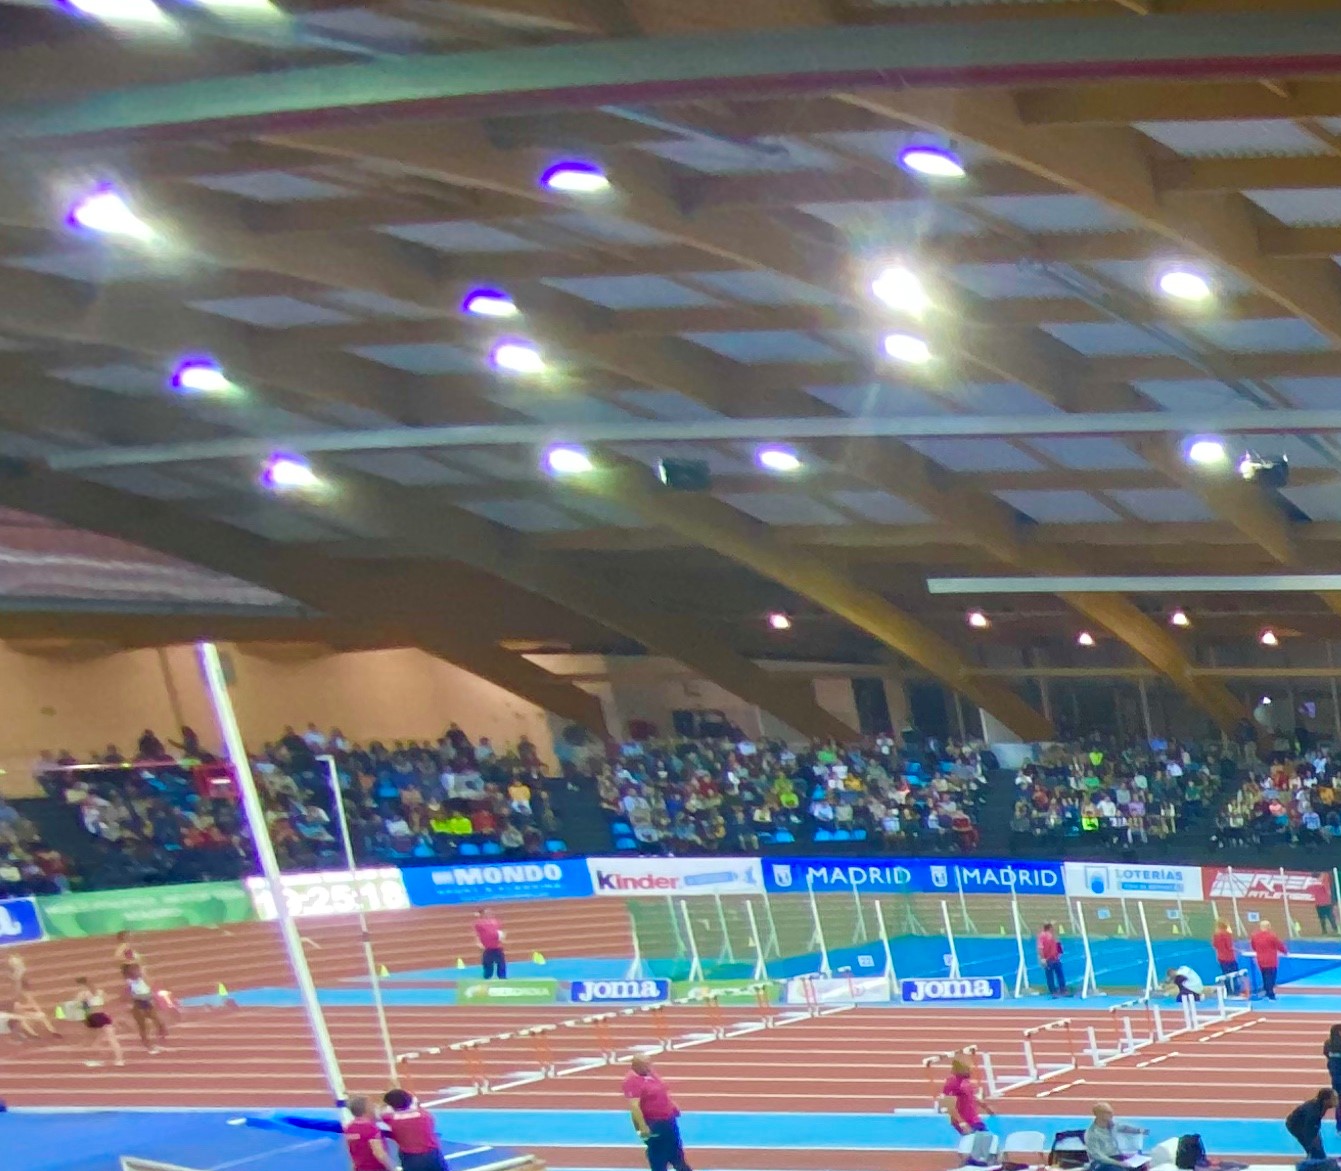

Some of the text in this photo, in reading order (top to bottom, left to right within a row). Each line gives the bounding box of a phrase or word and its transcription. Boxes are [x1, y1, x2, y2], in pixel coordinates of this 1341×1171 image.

[454, 864, 562, 885] MONDO
[808, 866, 911, 885] MADRID
[963, 868, 1058, 887] MADRID
